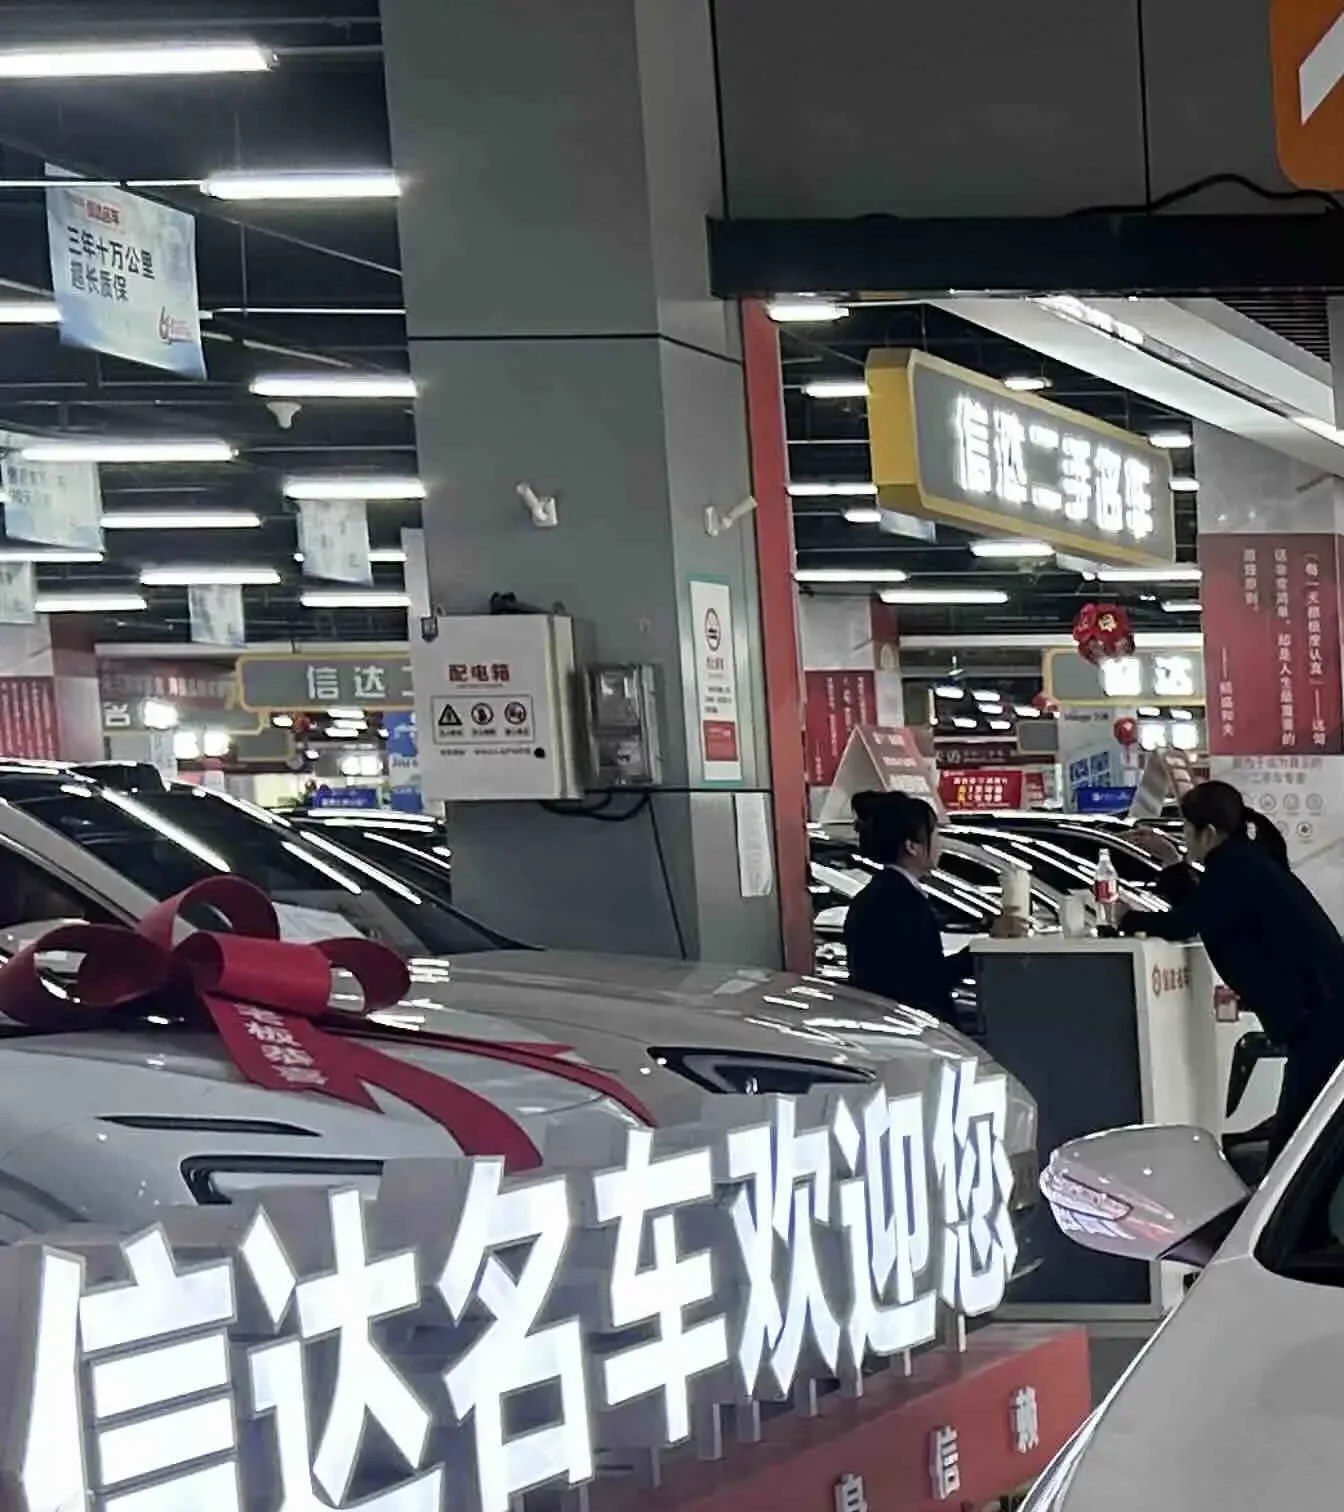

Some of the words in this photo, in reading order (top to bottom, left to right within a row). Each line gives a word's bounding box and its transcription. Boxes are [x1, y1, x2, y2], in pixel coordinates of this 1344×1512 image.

[67, 226, 155, 280] 三年十万公里
[448, 663, 509, 682] 配电箱
